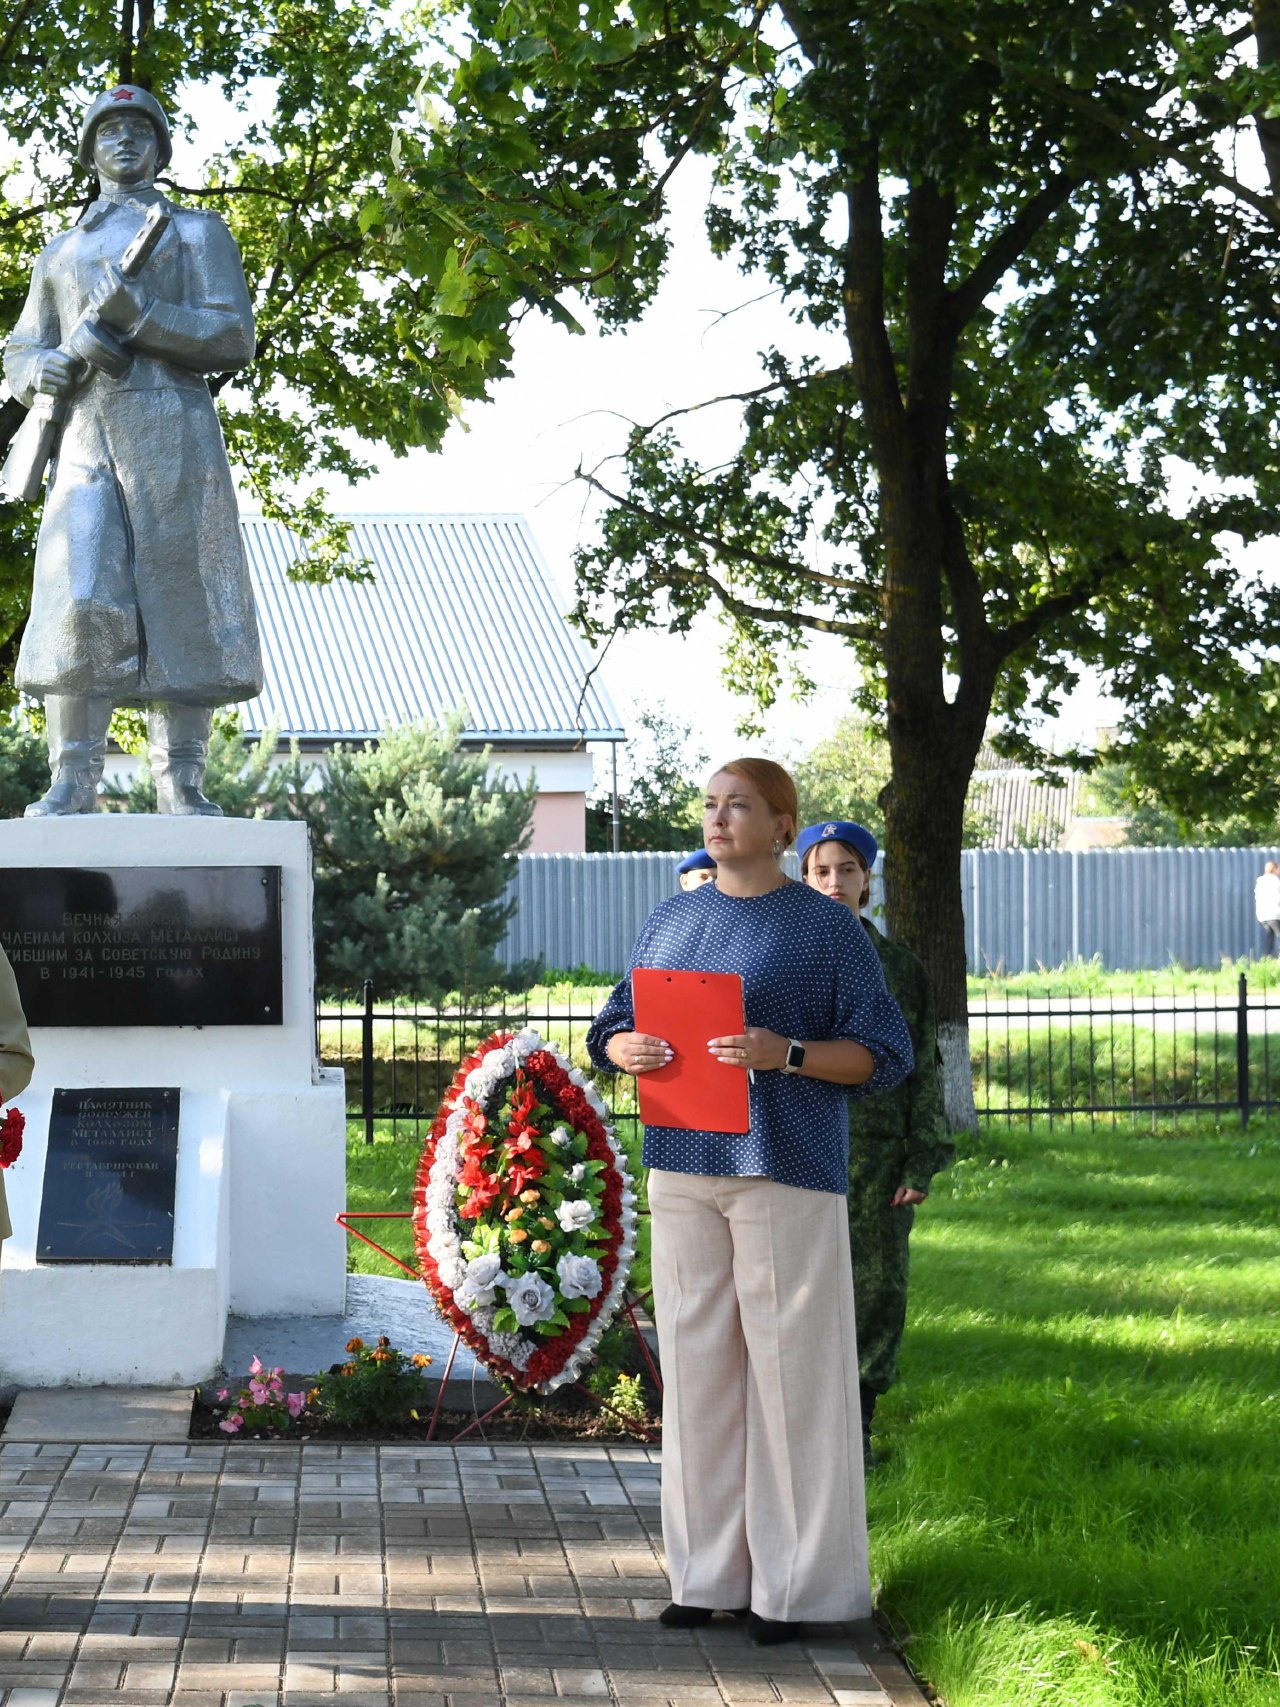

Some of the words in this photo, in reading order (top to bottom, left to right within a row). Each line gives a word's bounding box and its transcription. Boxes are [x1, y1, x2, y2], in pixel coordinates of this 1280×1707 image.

[62, 912, 122, 927] ВЕЧНАЯ
[2, 930, 65, 945] ЧЛЕНАМ
[73, 930, 141, 944] КОЛХОЗА
[151, 928, 240, 943] МЕТАЛЛИСТ
[6, 948, 68, 963] ГИБШИМ
[75, 948, 93, 962] ЗА
[102, 947, 192, 962] СОВЕТСКУЮ
[202, 946, 261, 960] РОДИНУ
[40, 966, 50, 980] В
[62, 966, 146, 980] 1941-1945
[156, 966, 204, 979] ГОДАХ
[79, 1101, 152, 1110] ПАМЯТНИК
[77, 1119, 152, 1128] КОЛХОЗОМ
[71, 1128, 153, 1138] МЕТАЛЛИСТ
[120, 1138, 156, 1146] ГОДУ
